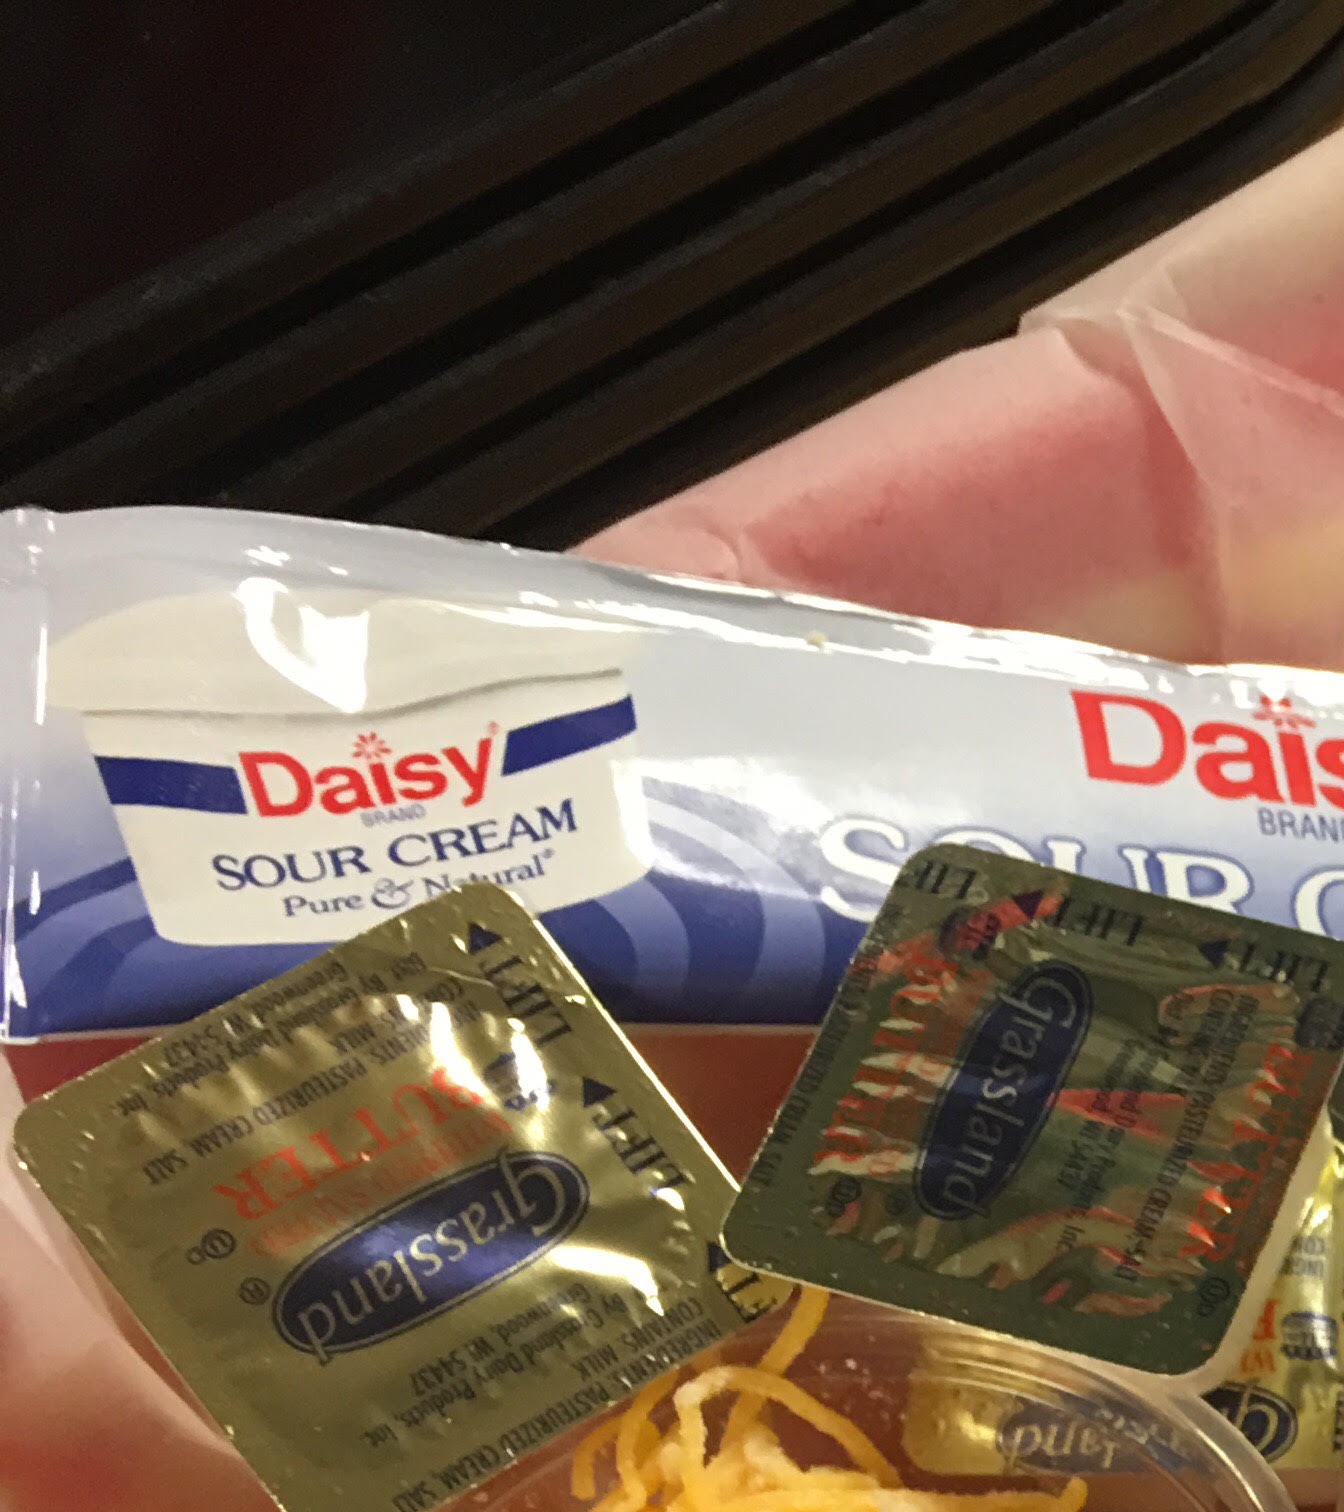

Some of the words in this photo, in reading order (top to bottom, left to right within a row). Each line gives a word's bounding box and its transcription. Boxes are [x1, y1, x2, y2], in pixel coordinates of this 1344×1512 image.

[238, 732, 493, 818] Daisy
[361, 804, 428, 829] BRAND
[212, 845, 371, 892] SOUR
[387, 798, 578, 867] CREAM
[819, 814, 1255, 922] SR
[283, 894, 363, 919] Pure
[1050, 896, 1145, 947] LIFT
[478, 954, 573, 1048] LIFT
[1232, 938, 1330, 995] LIFT
[938, 976, 1071, 1223] Grassland
[591, 1105, 685, 1199] LIFT
[292, 1147, 569, 1366] Grassland
[405, 1348, 468, 1397] 54437
[569, 1342, 620, 1385] MILK
[496, 1379, 612, 1459] PASTEURIZED
